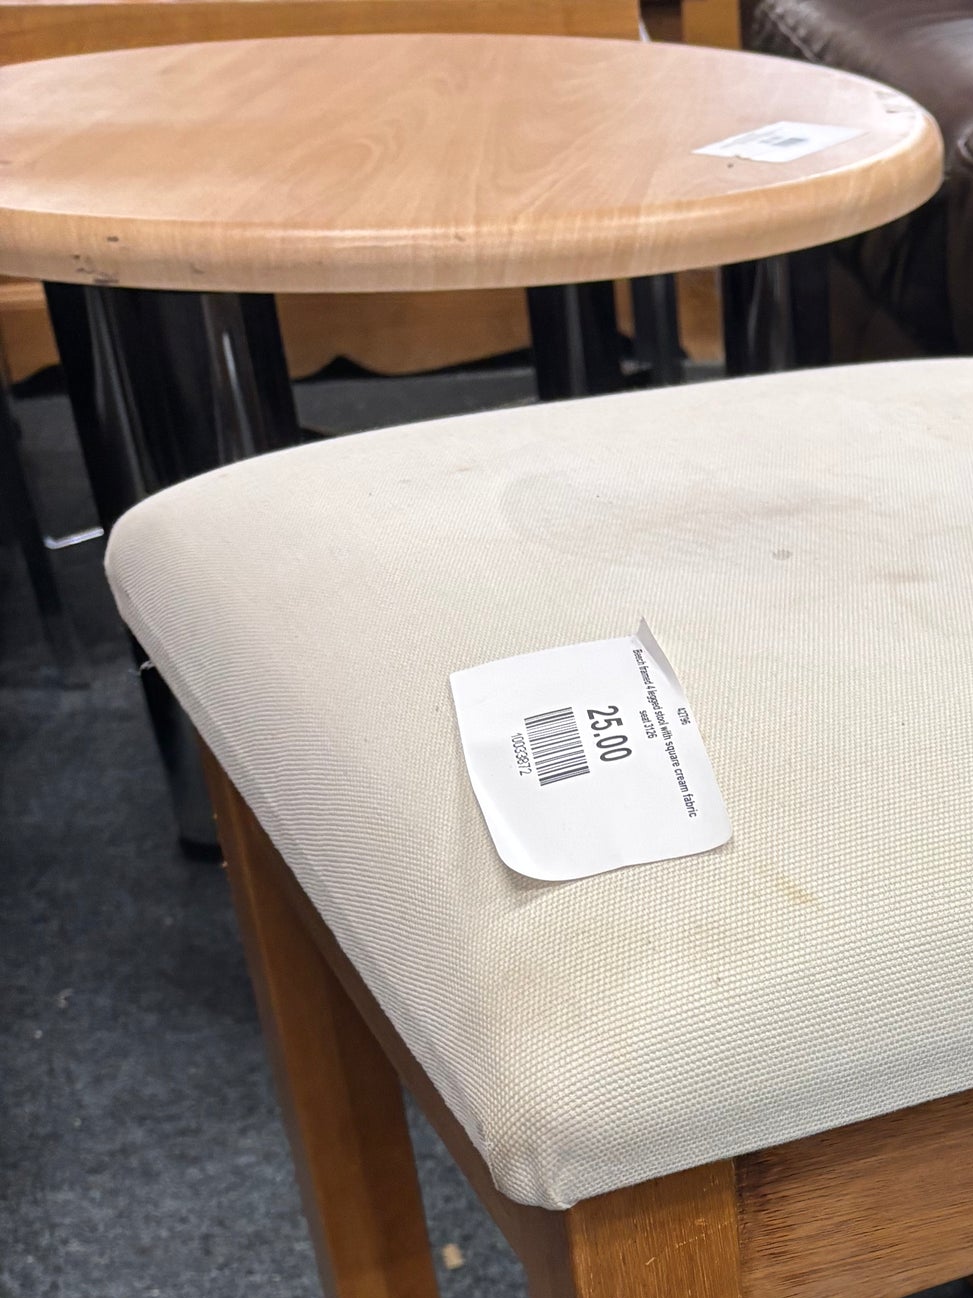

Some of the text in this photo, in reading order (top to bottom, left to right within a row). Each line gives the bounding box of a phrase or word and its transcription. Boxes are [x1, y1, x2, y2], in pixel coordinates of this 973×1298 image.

[632, 648, 646, 666] Beech
[639, 665, 653, 685] framed
[646, 689, 663, 711] legged
[639, 709, 658, 739] seat 3126
[654, 710, 669, 726] stool
[586, 705, 632, 762] 25.00
[660, 726, 673, 741] with
[665, 741, 680, 768] square
[674, 768, 689, 793] cream
[682, 793, 698, 818] fabric
